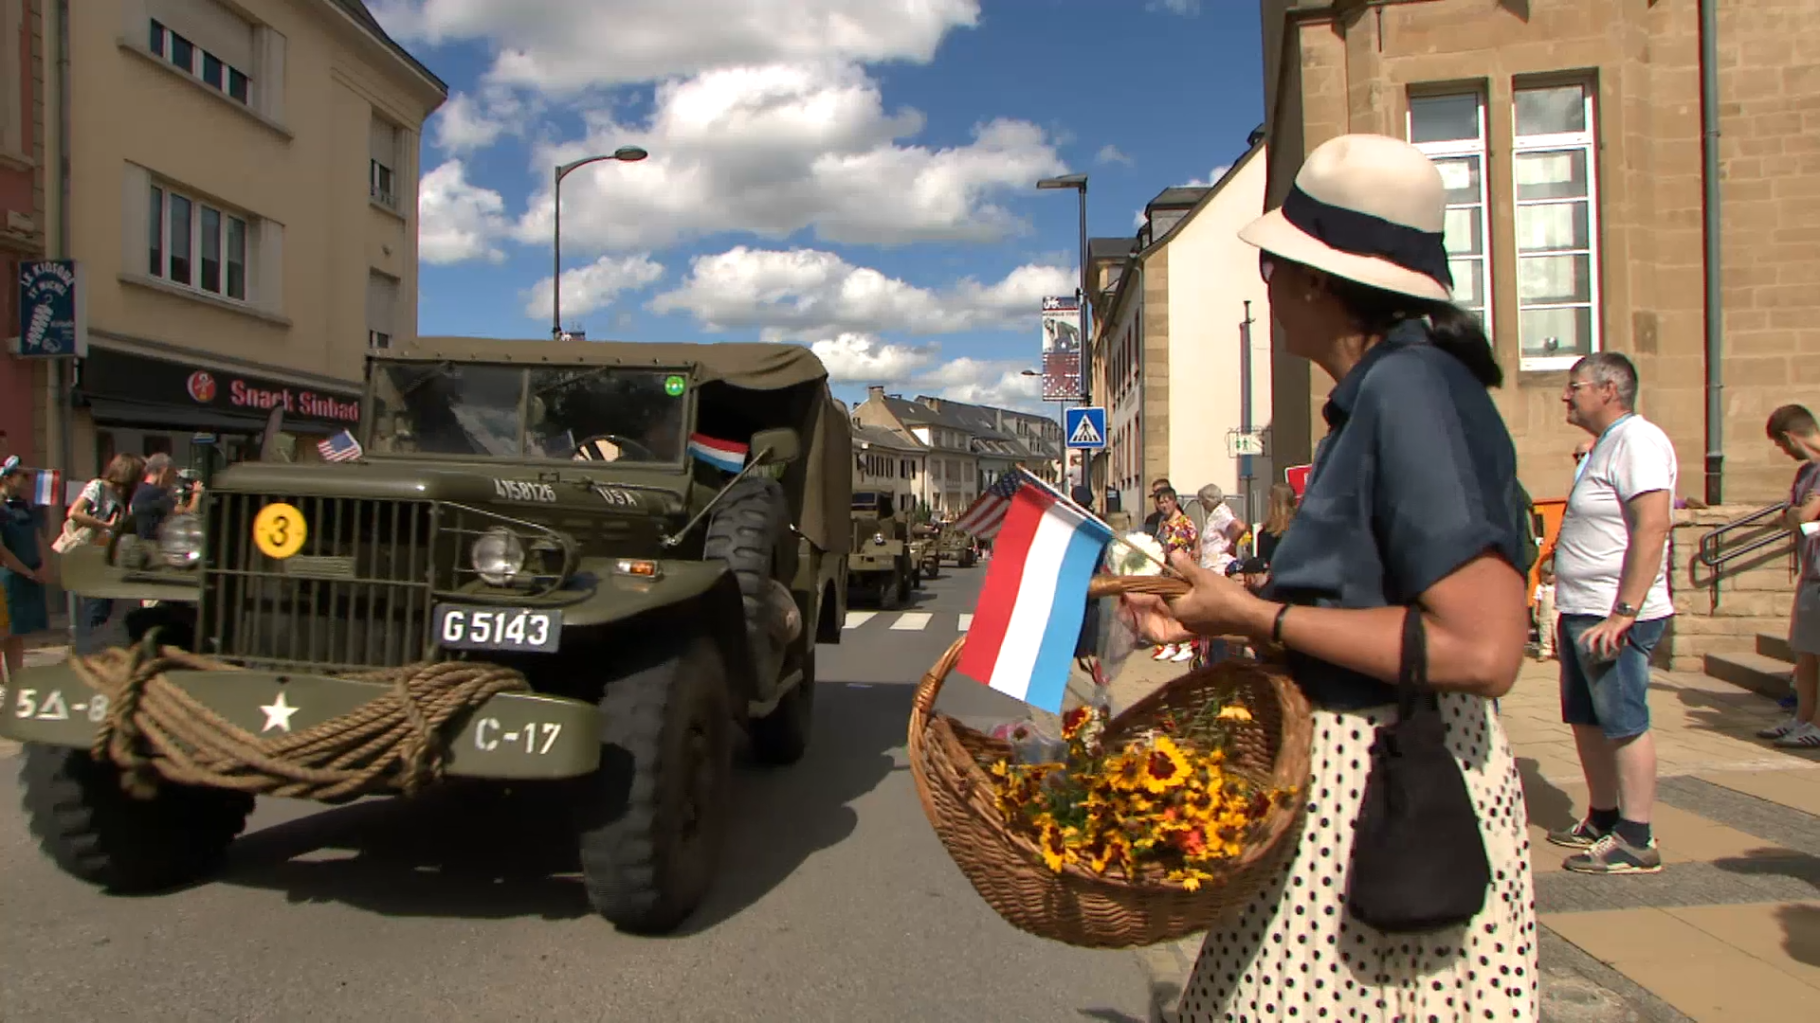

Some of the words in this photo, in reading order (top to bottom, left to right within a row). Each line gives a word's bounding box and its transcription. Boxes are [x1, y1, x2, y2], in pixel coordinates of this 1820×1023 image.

[230, 379, 294, 412] Snack
[299, 391, 359, 422] Sinbad
[493, 478, 557, 503] 4158126
[269, 516, 290, 547] 3
[443, 611, 464, 642] G
[470, 611, 550, 646] 5143
[475, 717, 562, 755] C-17
